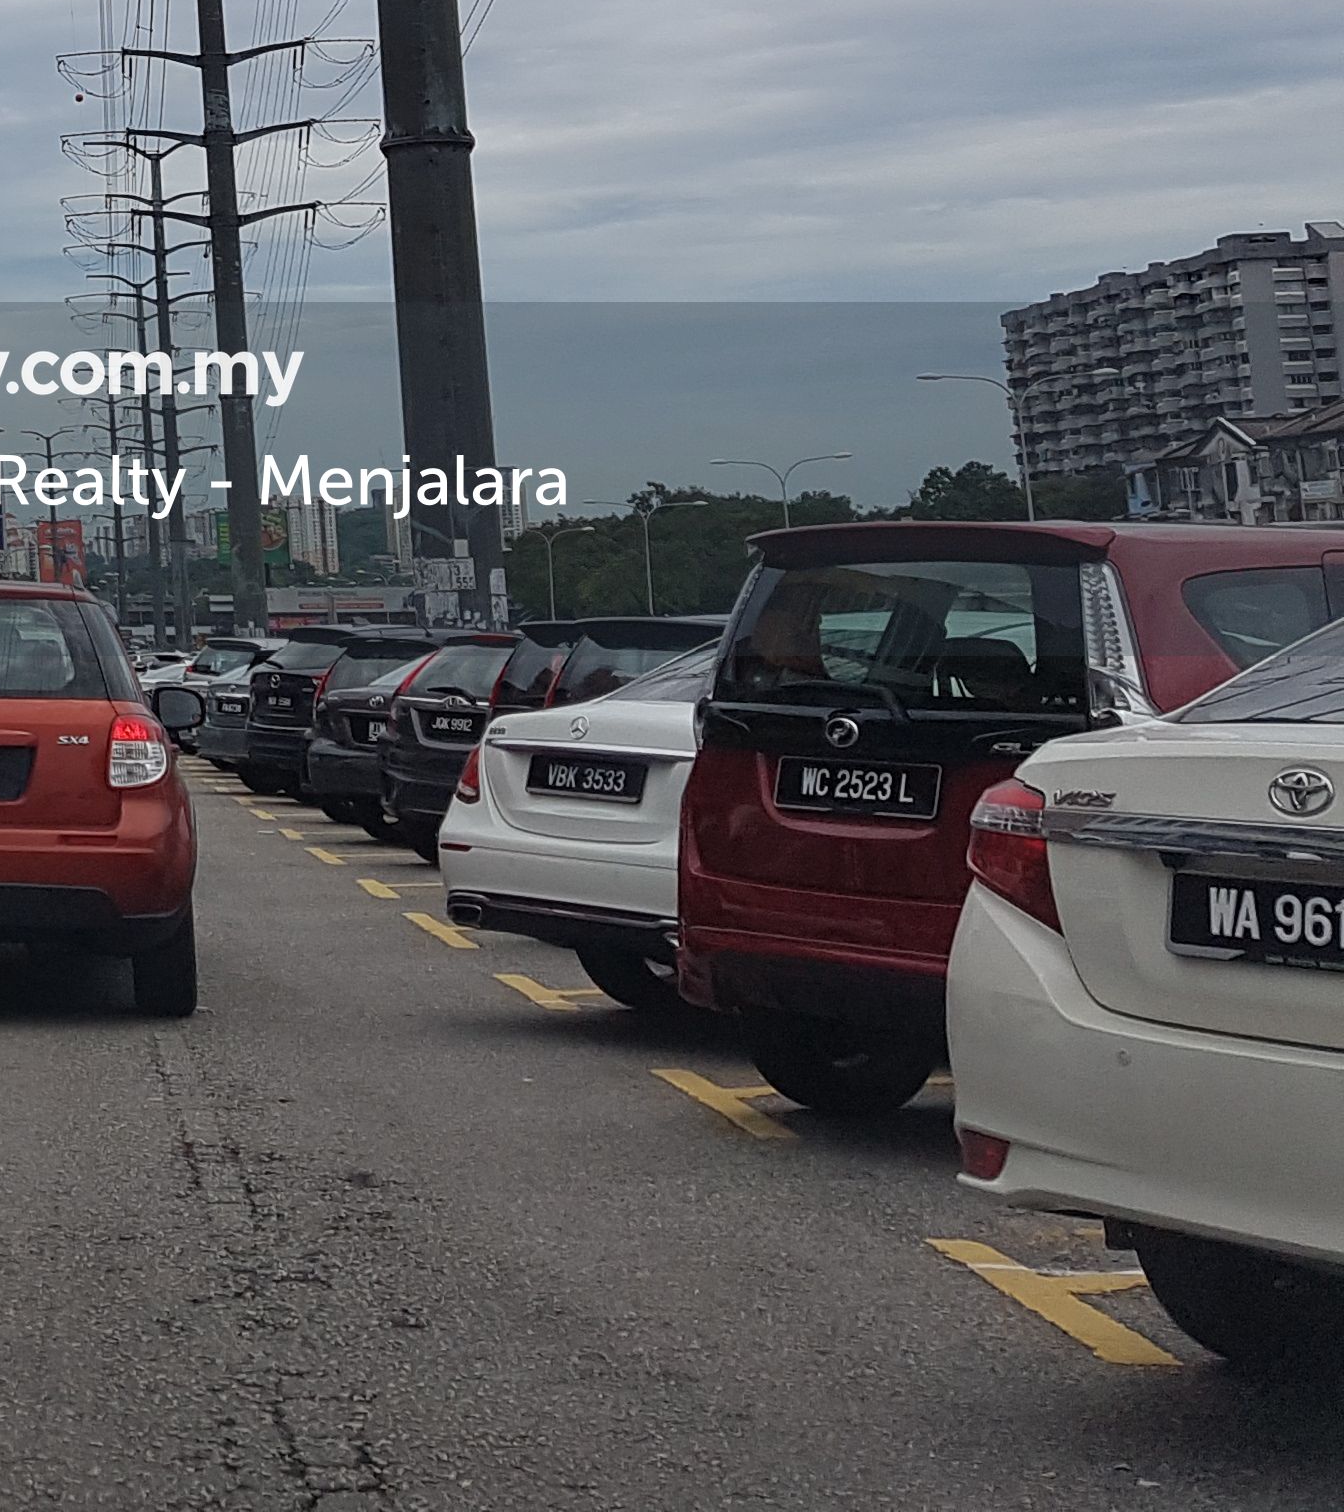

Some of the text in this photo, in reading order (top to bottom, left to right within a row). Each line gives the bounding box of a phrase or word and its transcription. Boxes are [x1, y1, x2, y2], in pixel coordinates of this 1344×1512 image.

[57, 735, 90, 745] SX4
[547, 763, 627, 792] VBK 3533
[801, 766, 914, 804] WC 2523 L
[1209, 886, 1261, 940] WA
